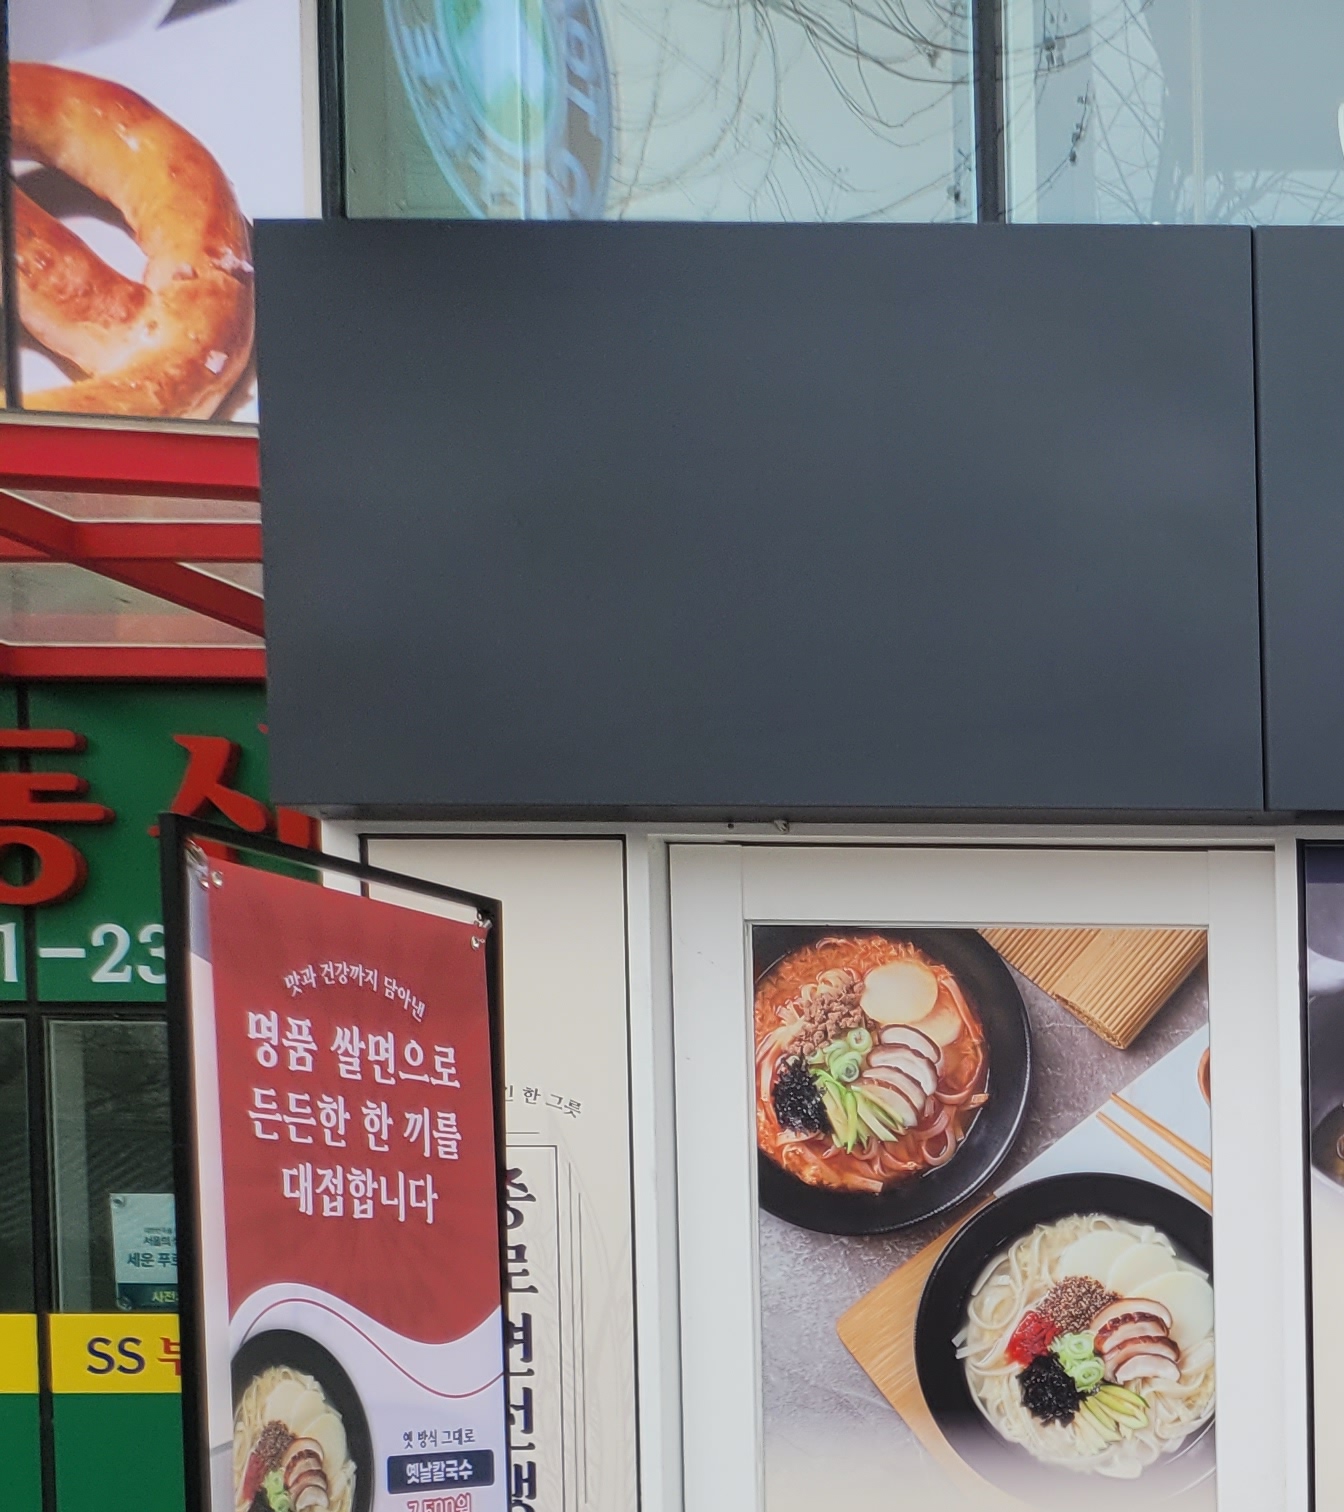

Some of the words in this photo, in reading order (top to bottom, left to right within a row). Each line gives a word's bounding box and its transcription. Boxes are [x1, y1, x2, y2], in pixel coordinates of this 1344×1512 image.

[284, 964, 317, 998] 맛과
[319, 961, 379, 992] 건강까지
[383, 976, 426, 1023] 담아낸
[247, 1009, 319, 1074] 명품
[330, 1025, 462, 1089] 쌀면으로
[522, 1086, 542, 1105] 한
[545, 1093, 582, 1119] 그릇
[247, 1086, 351, 1148] 든든한
[360, 1099, 394, 1153] 한
[403, 1106, 463, 1161] 끼를
[280, 1161, 439, 1225] 대접합니다
[127, 1251, 154, 1268] 세운
[87, 1336, 146, 1375] SS
[402, 1430, 414, 1450] 옛
[417, 1428, 438, 1449] 방식
[441, 1427, 476, 1446] 그대로
[405, 1458, 474, 1485] 옛날칼국수
